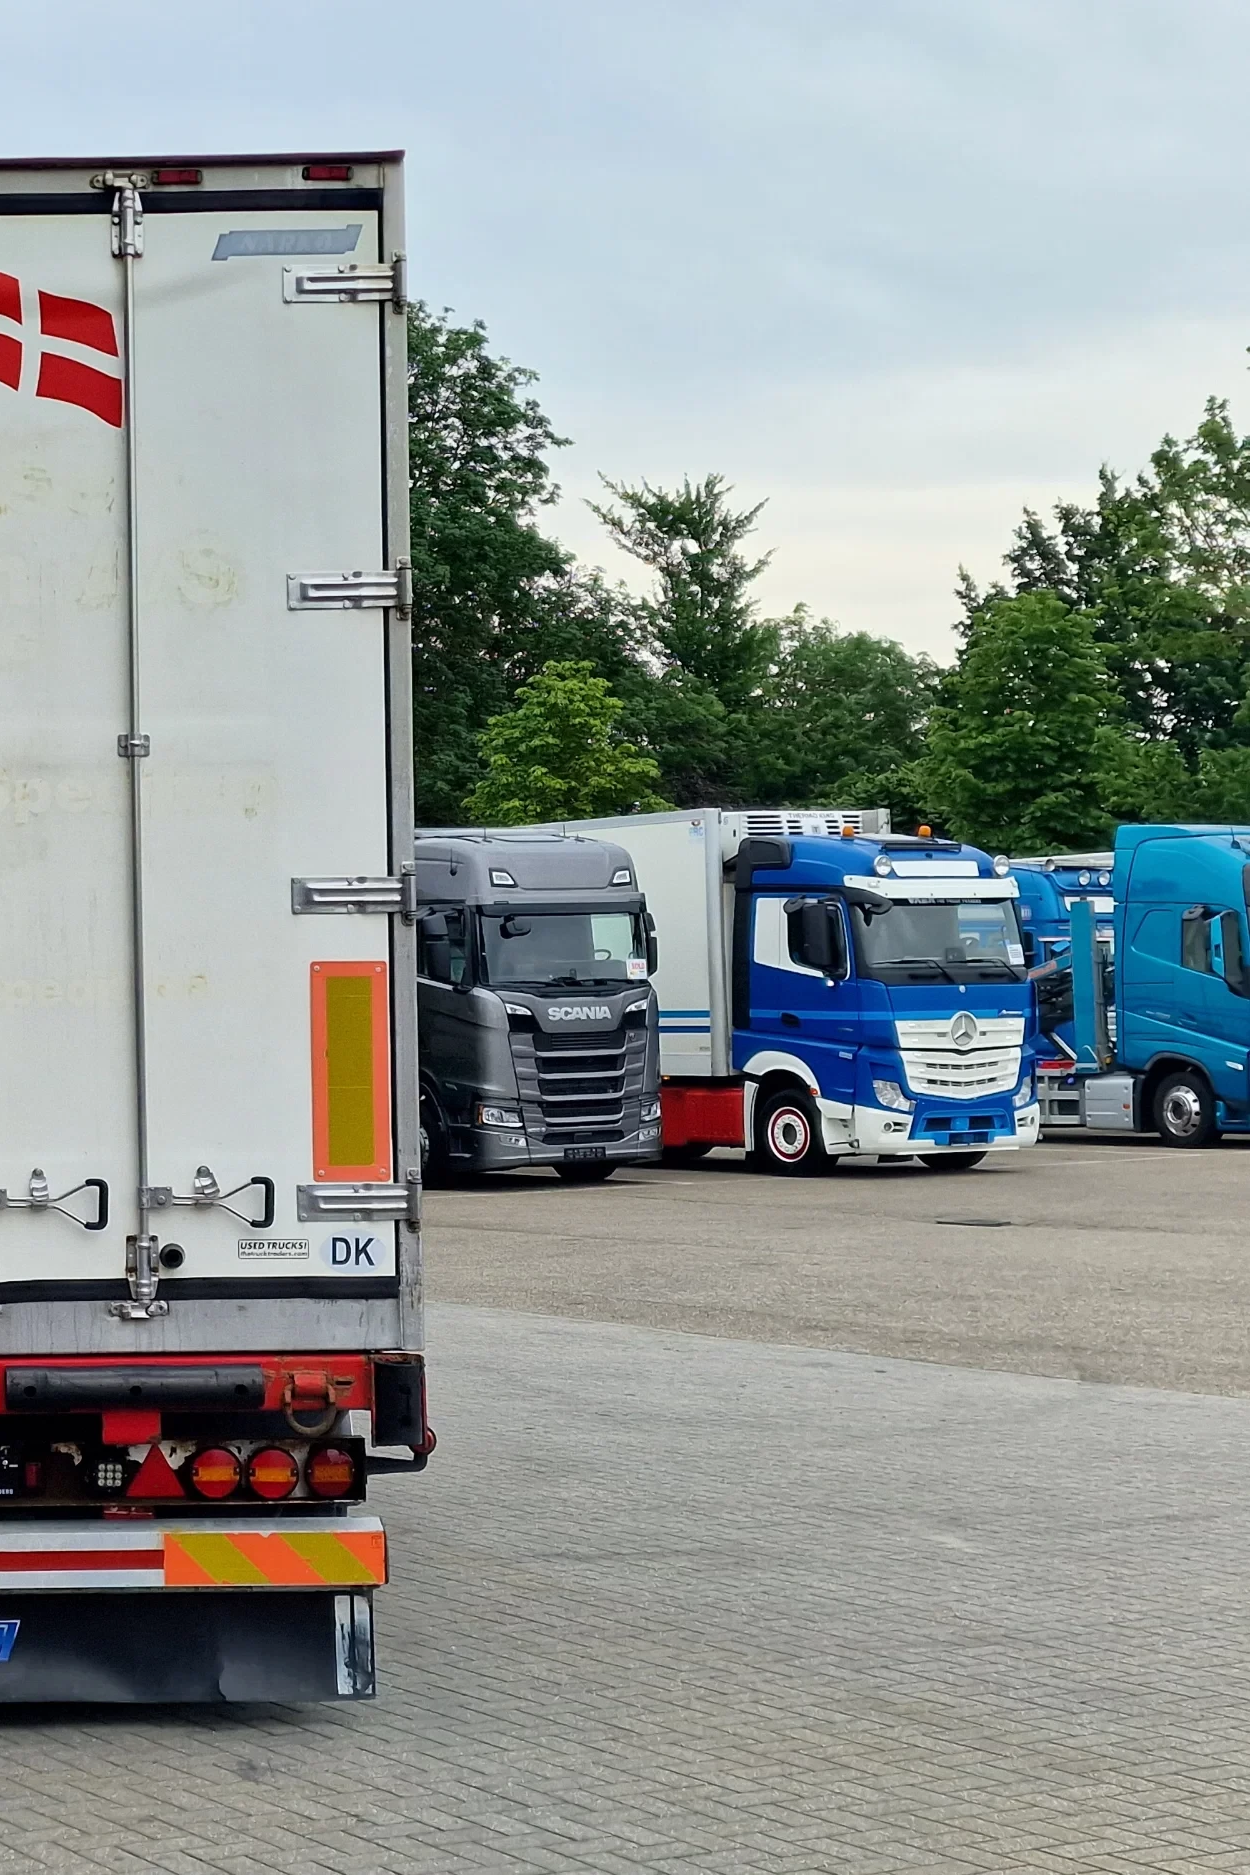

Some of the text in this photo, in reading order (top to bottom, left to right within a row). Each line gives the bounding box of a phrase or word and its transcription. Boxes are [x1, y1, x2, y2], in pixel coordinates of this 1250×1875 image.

[547, 1006, 611, 1020] SCANIA
[240, 1241, 307, 1250] USED TRUCKS!
[331, 1237, 376, 1266] DK
